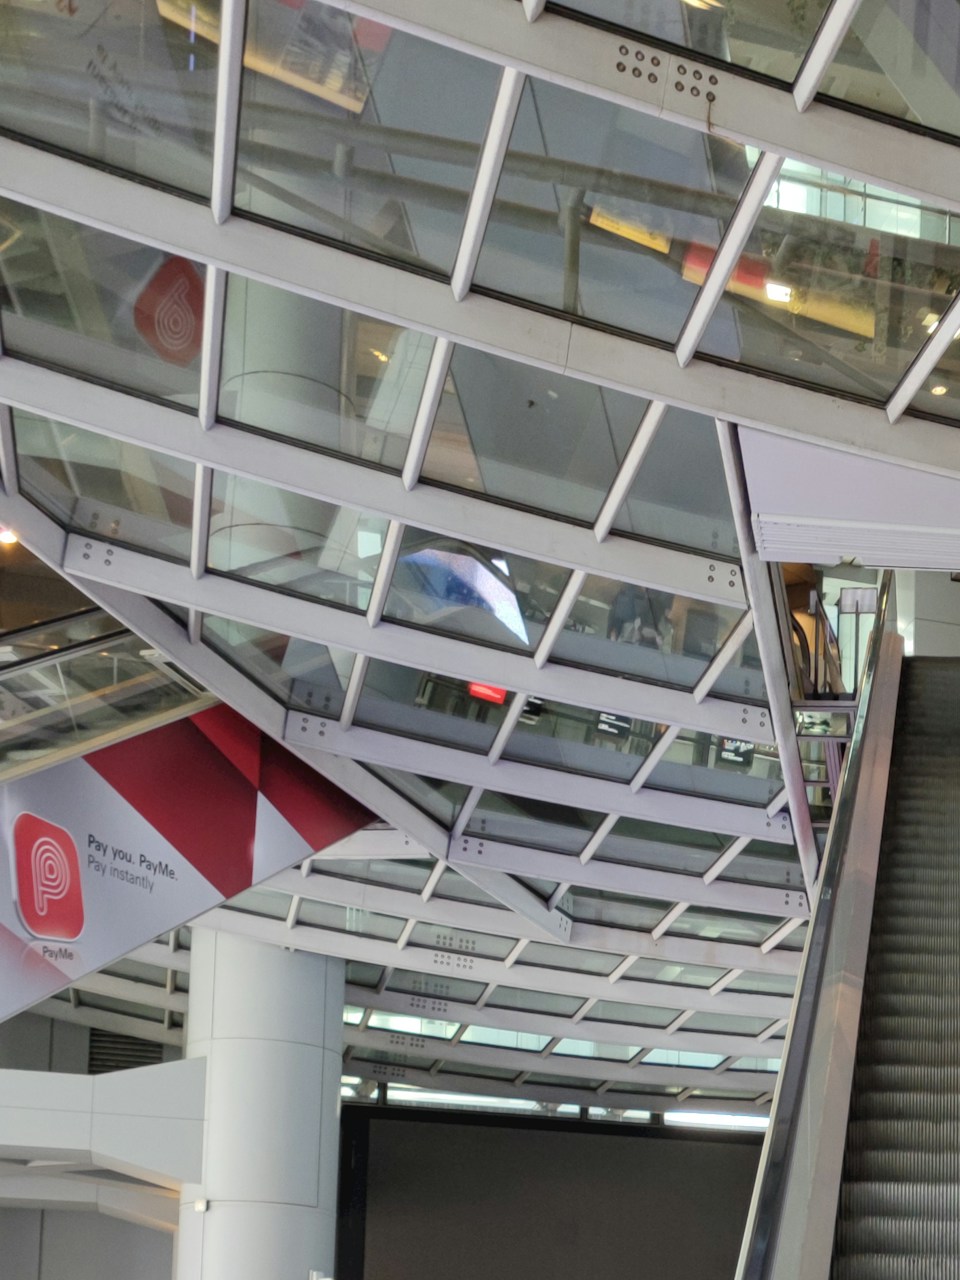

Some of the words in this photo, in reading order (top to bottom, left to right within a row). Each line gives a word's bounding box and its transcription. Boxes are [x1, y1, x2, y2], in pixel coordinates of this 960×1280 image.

[87, 834, 108, 856] Pay
[111, 847, 135, 865] you.
[139, 854, 179, 881] PayMe.
[87, 854, 107, 876] Pay
[109, 862, 154, 893] instantly
[41, 946, 74, 961] PayMe
